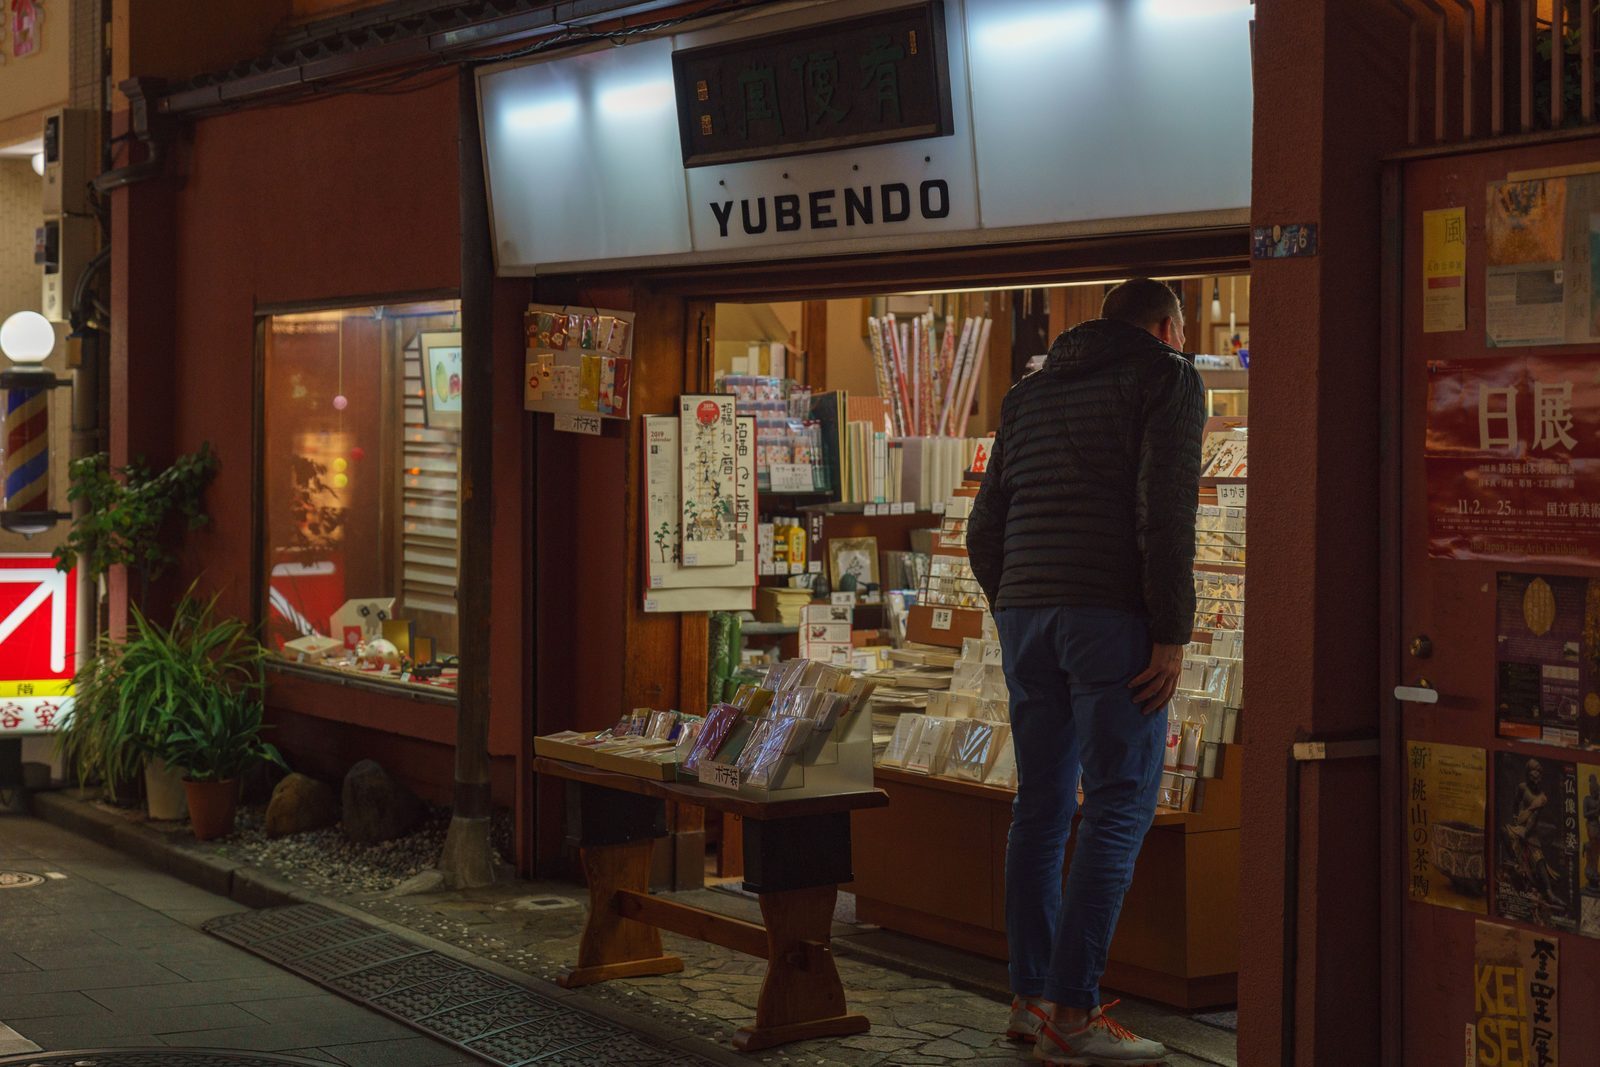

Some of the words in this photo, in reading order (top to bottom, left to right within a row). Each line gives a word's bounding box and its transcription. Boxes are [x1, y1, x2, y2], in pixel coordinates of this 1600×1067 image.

[709, 179, 950, 237] YUBENDO
[1444, 216, 1464, 244] 風
[573, 416, 599, 432] ポチ袋
[1478, 381, 1578, 451] 日展
[719, 402, 734, 475] 招福ねこ暦
[1221, 486, 1245, 499] はがき
[715, 766, 738, 787] ポチ袋
[1474, 961, 1527, 1017] KEI
